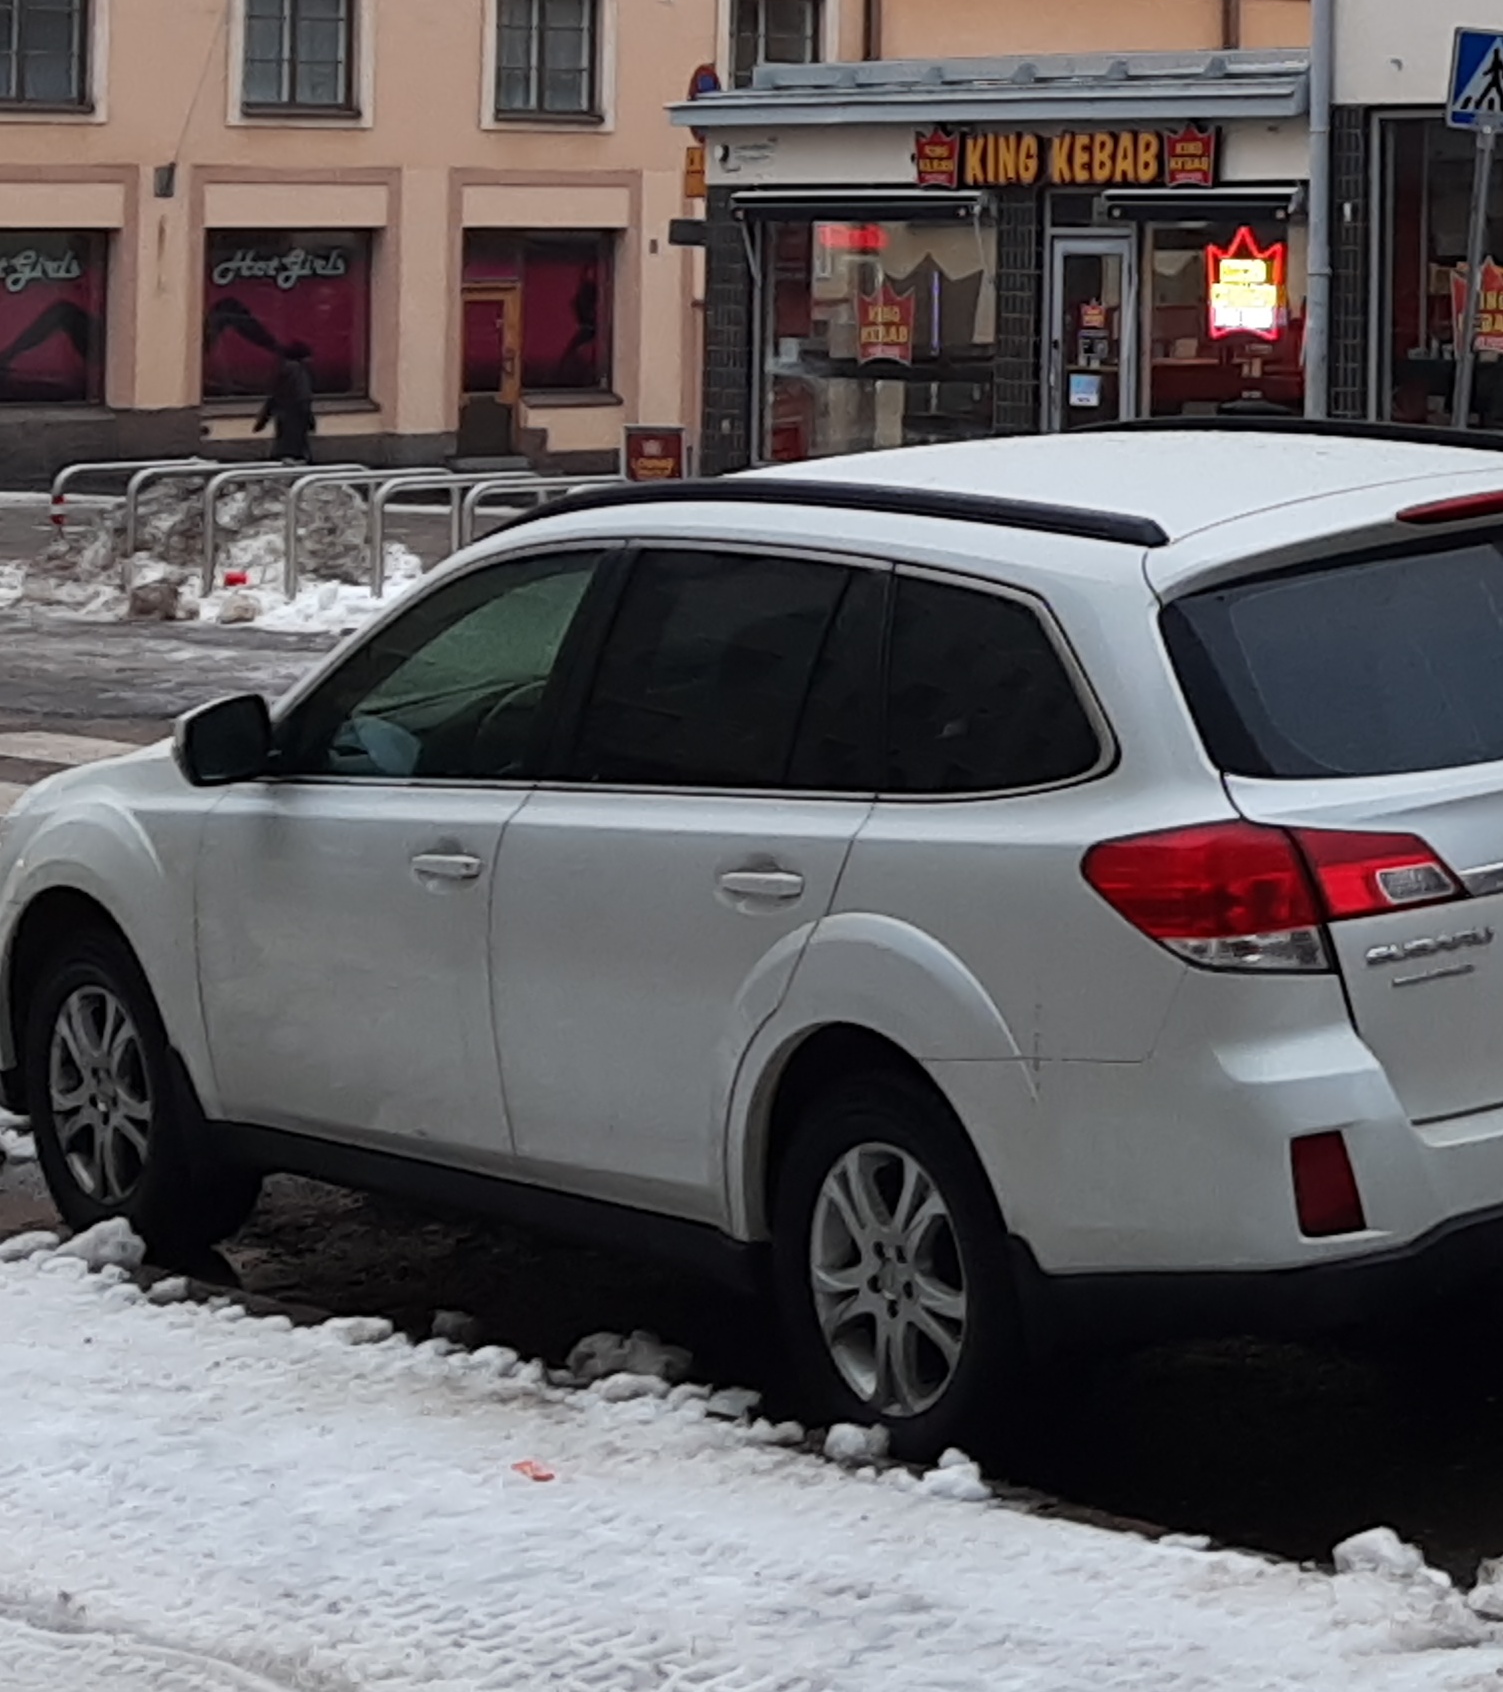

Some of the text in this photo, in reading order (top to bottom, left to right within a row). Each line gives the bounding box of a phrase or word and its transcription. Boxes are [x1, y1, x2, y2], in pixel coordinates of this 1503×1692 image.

[965, 131, 1160, 186] KING KEBAB
[276, 249, 347, 289] Girls
